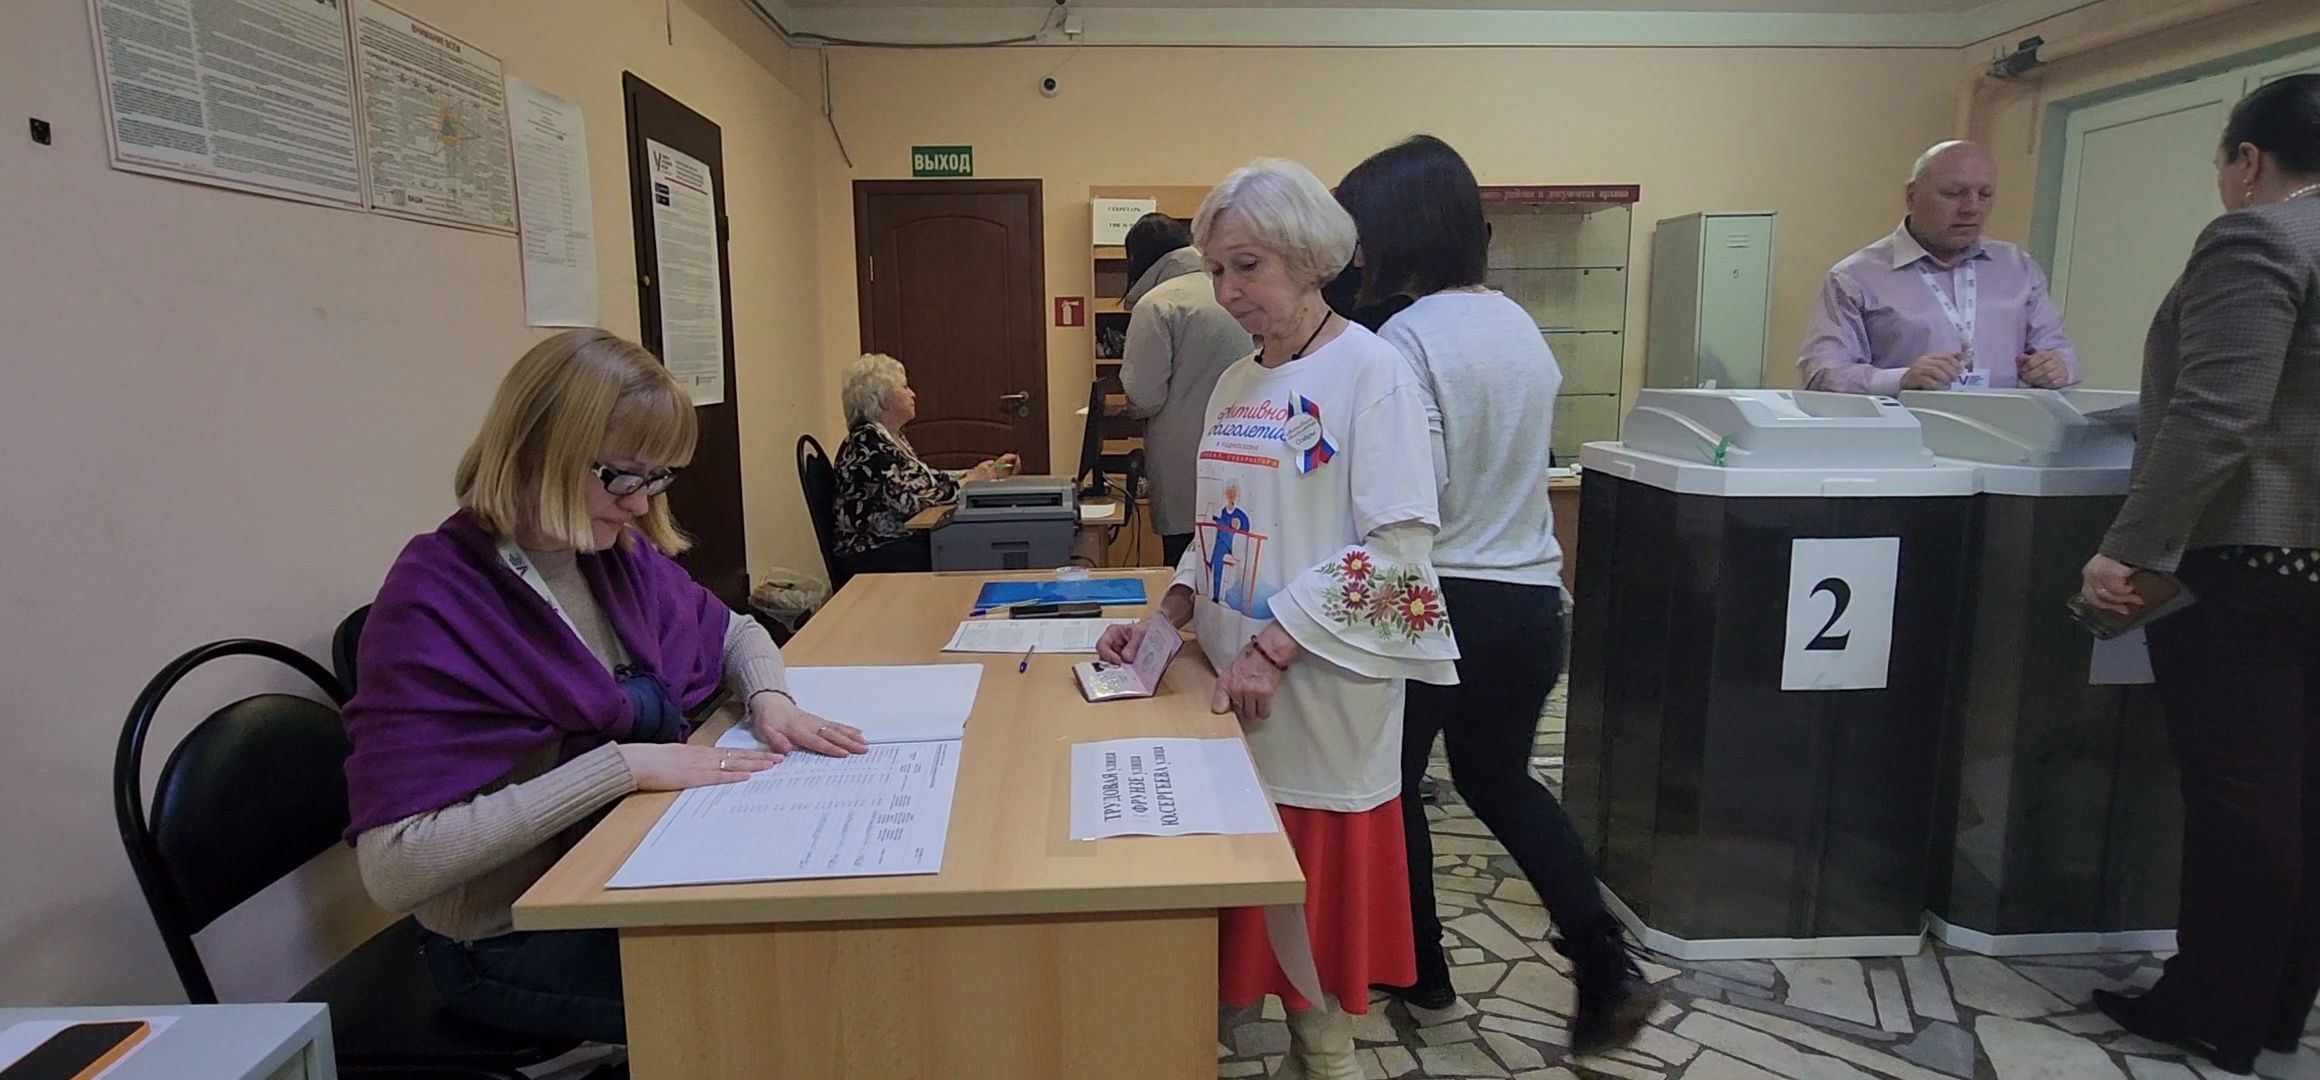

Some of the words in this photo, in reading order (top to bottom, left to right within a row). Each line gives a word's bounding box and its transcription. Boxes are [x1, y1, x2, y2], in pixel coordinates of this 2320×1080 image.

[913, 153, 971, 173] ВЫХОД
[1804, 577, 1851, 651] 2
[1101, 772, 1122, 822] ТРУДОВАЯ
[1128, 776, 1149, 814] ФРУНЗЕ
